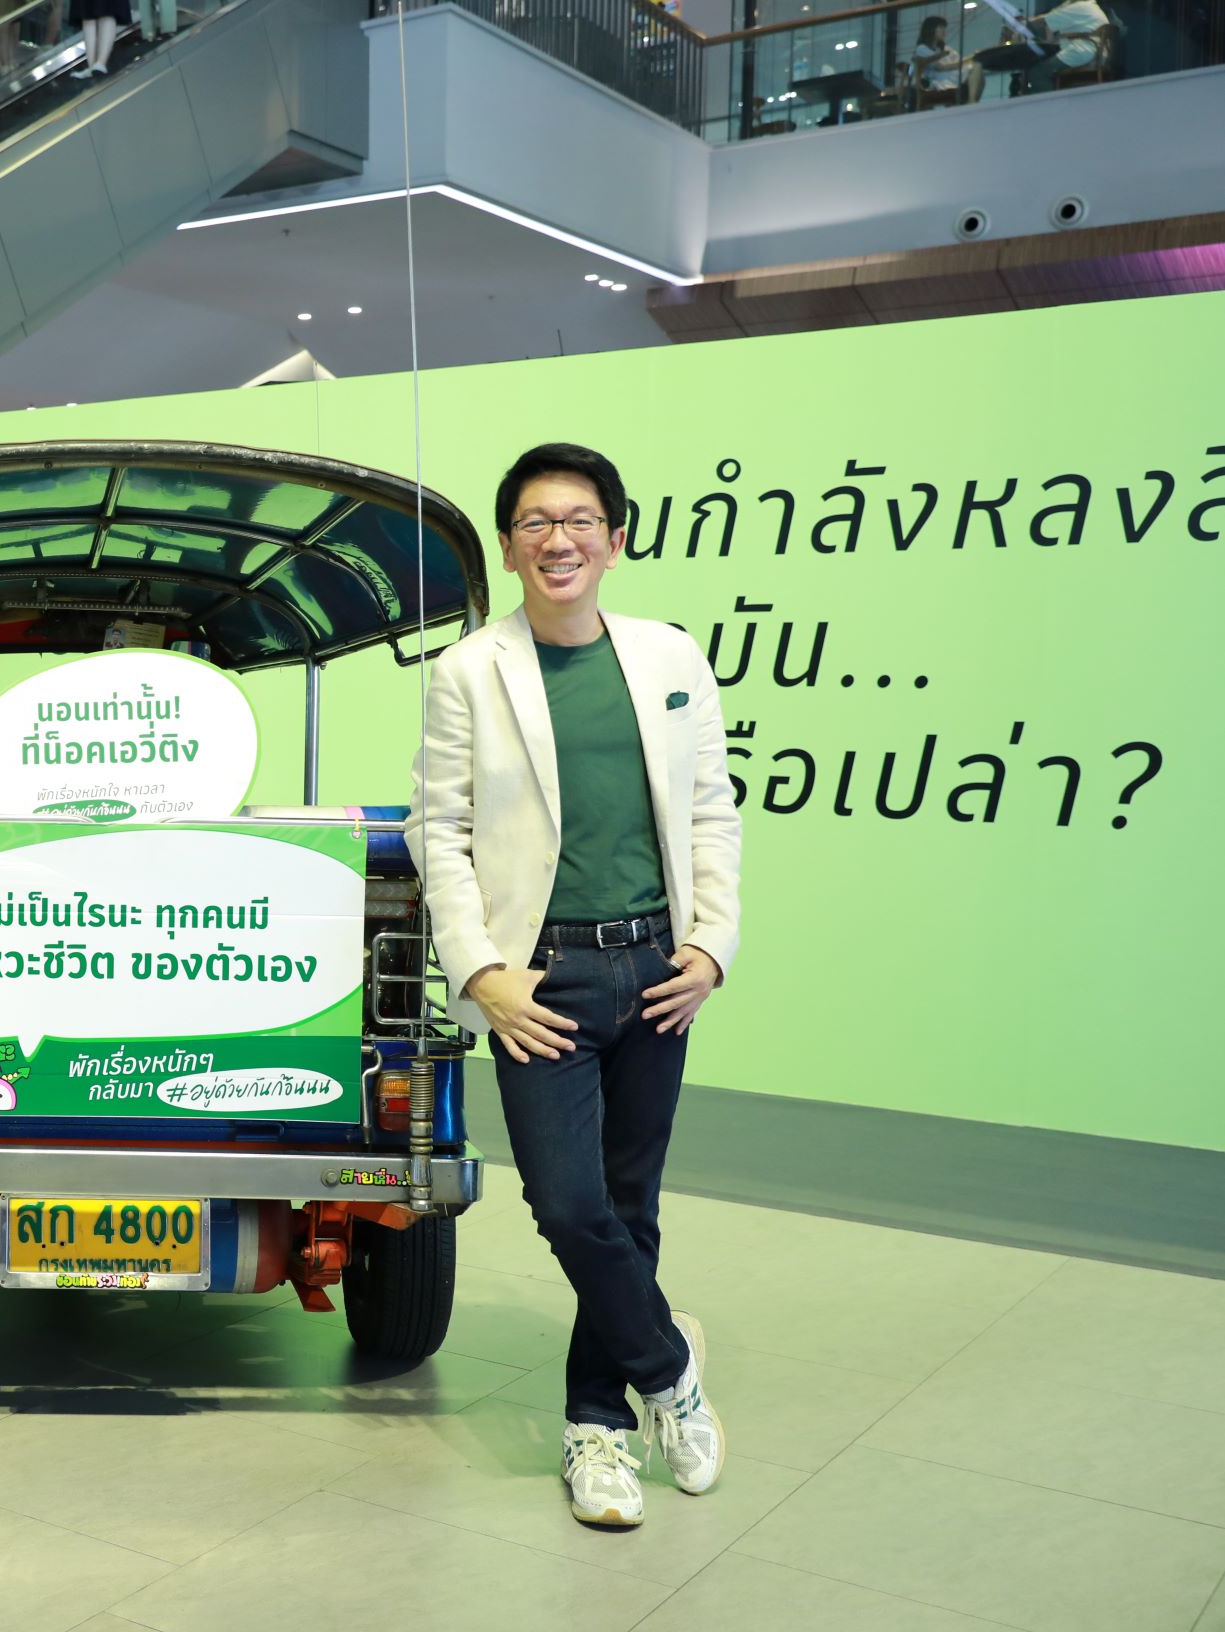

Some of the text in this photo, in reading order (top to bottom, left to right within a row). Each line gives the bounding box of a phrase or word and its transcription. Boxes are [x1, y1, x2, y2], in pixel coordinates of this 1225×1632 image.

[37, 683, 181, 722] นอนเท่านั้น!
[124, 784, 165, 796] หาเวลา
[139, 801, 194, 815] กับตัวเอง
[156, 896, 270, 940] ทุกคนมี
[131, 942, 318, 983] ของตัวเอง
[68, 1045, 214, 1078] พักเรื่องหนักๆ
[88, 1079, 154, 1101] กลับมา
[16, 1201, 194, 1245] สก 4800
[38, 1257, 172, 1273] กรงเทพมหานคร
